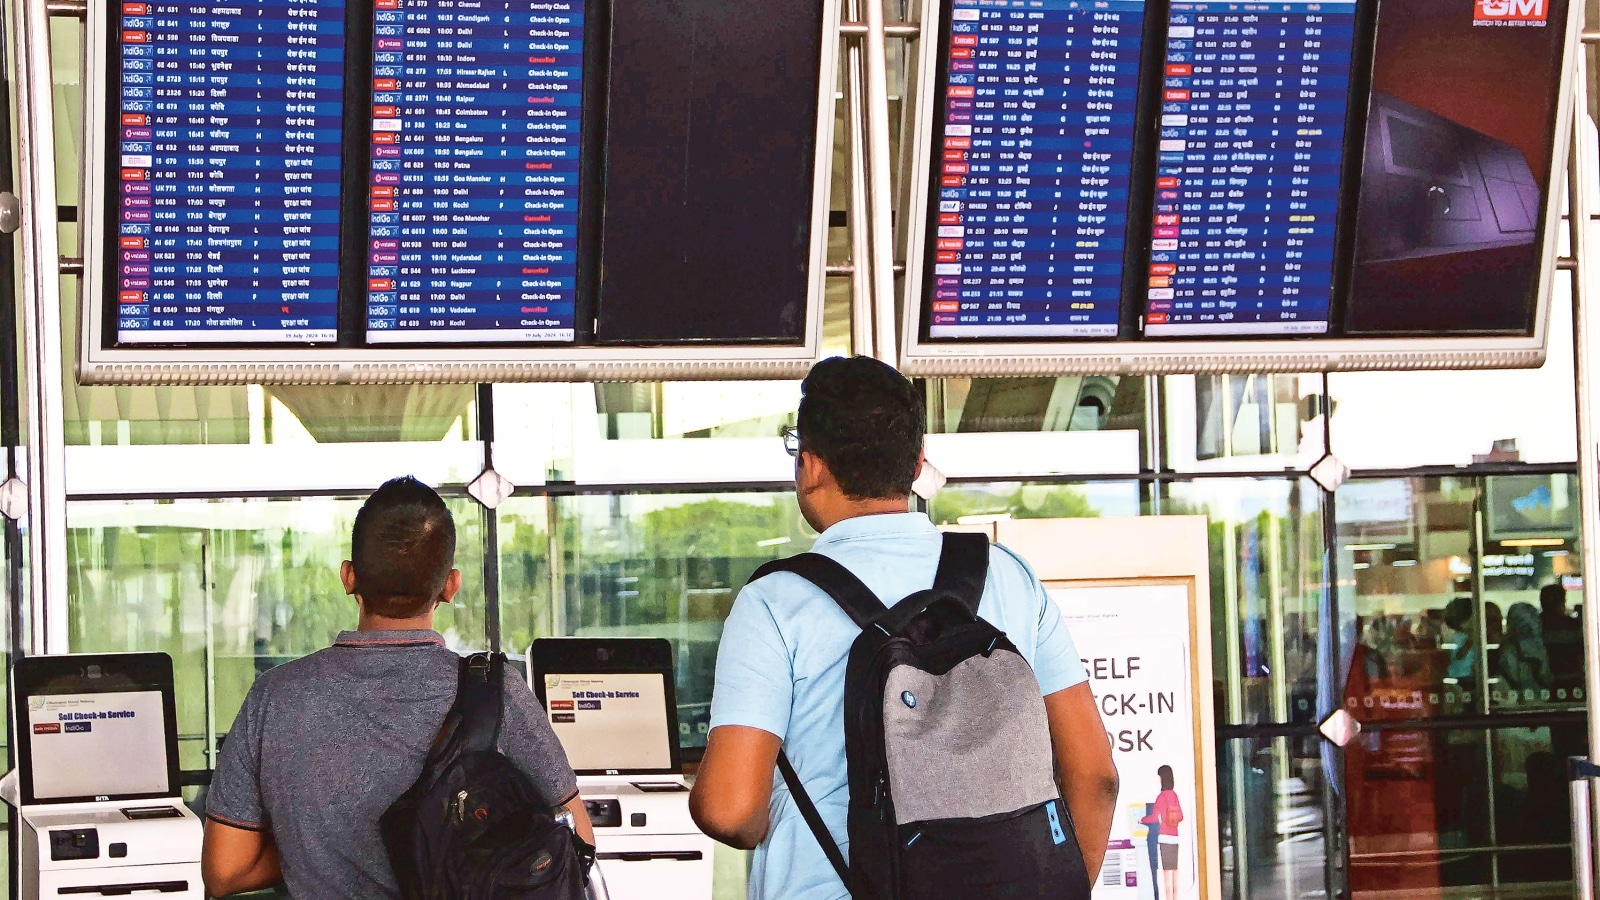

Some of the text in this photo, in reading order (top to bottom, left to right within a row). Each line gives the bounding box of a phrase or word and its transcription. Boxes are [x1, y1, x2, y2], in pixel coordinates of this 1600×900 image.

[530, 3, 553, 11] Security
[124, 20, 144, 28] IndiGo
[458, 15, 490, 23] Chandigarh
[530, 16, 554, 24] Check-in
[554, 16, 570, 25] Open
[553, 43, 569, 51] Open
[376, 54, 394, 62] IndiGo
[376, 68, 394, 76] IndiGo
[124, 75, 143, 83] IndiGo
[374, 96, 393, 104] IndiGo
[551, 123, 567, 131] Open
[455, 136, 484, 144] Bengaluru
[455, 149, 483, 157] Bengaluru
[549, 176, 565, 184] Open
[122, 226, 142, 234] IndiGo
[451, 281, 472, 289] Nagpur
[369, 294, 388, 302] IndiGo
[545, 293, 561, 301] Open
[120, 306, 140, 314] IndiGo
[120, 320, 140, 328] IndiGo
[369, 319, 388, 328] IndiGo
[1094, 692, 1174, 717] CK-IN
[74, 711, 106, 720] Check-in
[107, 710, 135, 719] Service
